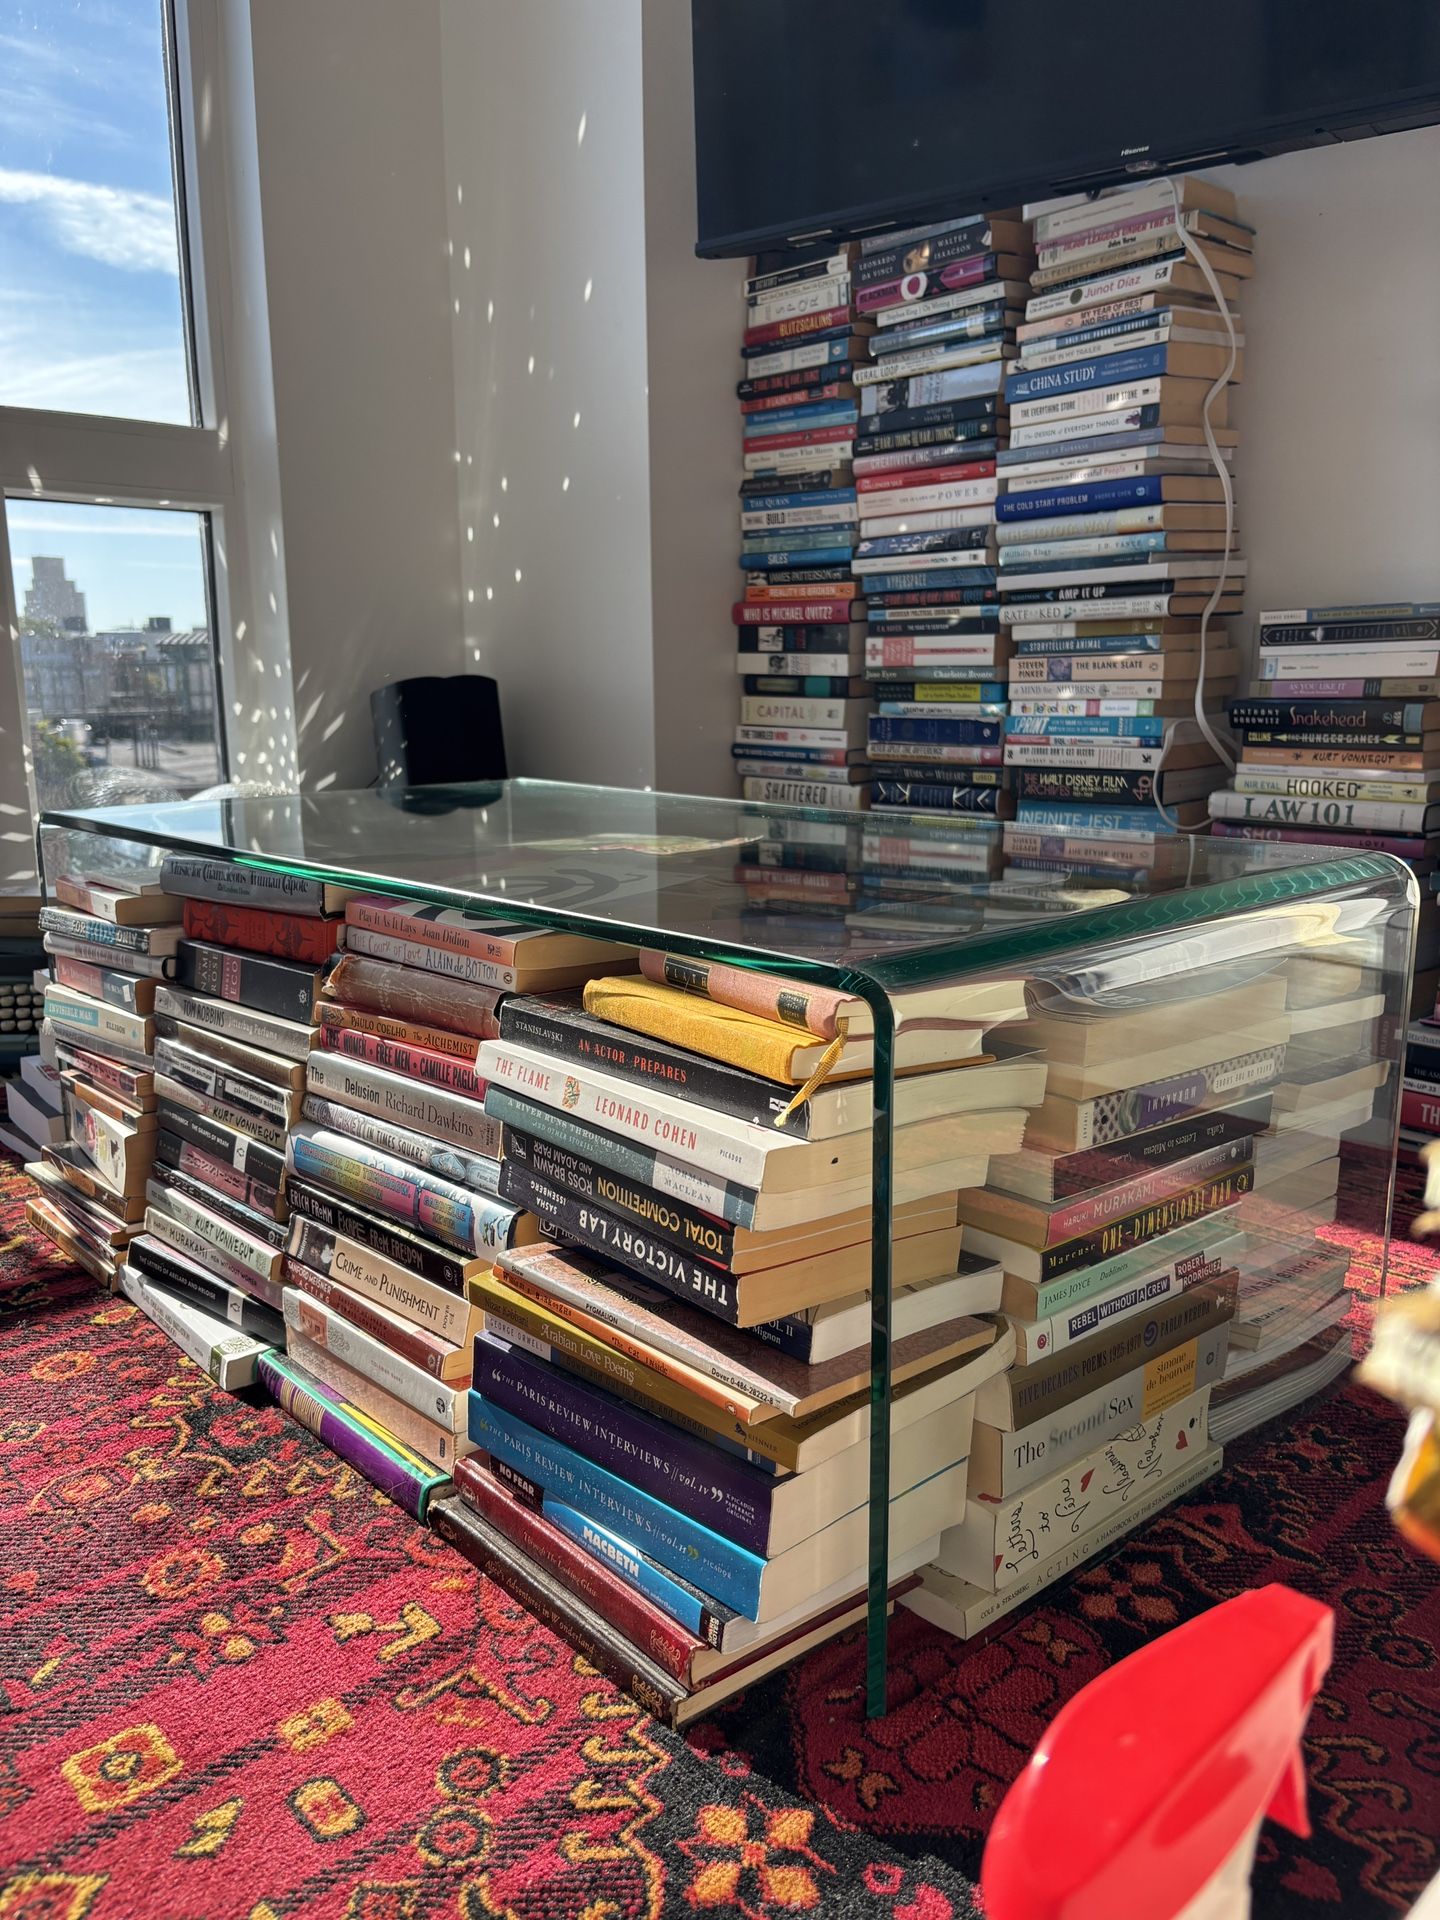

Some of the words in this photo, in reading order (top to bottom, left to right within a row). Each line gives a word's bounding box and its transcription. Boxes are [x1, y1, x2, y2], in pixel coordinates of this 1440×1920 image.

[1121, 145, 1149, 156] Hisense
[937, 233, 968, 248] WALTER
[858, 254, 896, 271] LEONARDO
[1084, 280, 1115, 299] Junot
[1080, 309, 1094, 319] MY
[1096, 305, 1114, 317] YEAR
[1114, 302, 1123, 313] OF
[1124, 298, 1143, 311] REST
[779, 313, 832, 337] BLITZSCALING
[1081, 316, 1095, 327] AND
[1030, 371, 1062, 392] CHINA
[1063, 366, 1096, 385] STUDY
[1021, 408, 1030, 418] THE
[1031, 404, 1059, 417] EVERYTHING
[1061, 401, 1075, 412] STORE
[1033, 428, 1056, 439] DESIGN
[1064, 423, 1094, 436] EVERYDAY
[1096, 418, 1120, 430] THINGS
[937, 488, 980, 499] POWER
[1003, 504, 1015, 512] THE
[1017, 501, 1034, 511] COLD
[1035, 498, 1055, 508] START
[1057, 494, 1088, 507] PROBLEM
[767, 512, 786, 524] BUILD
[769, 587, 796, 597] REALITY
[798, 587, 806, 595] IS
[1059, 588, 1080, 601] AMP
[1082, 587, 1091, 599] IT
[1092, 585, 1105, 597] UP
[743, 608, 761, 621] WHO
[763, 608, 770, 621] IS
[772, 607, 802, 621] MICHAEL
[803, 606, 832, 620] OVITZ?
[1029, 641, 1074, 651] STORYTELLING
[1075, 640, 1101, 649] ANIMAL
[865, 670, 881, 678] Jane
[883, 671, 896, 679] Eyre
[933, 670, 966, 679] Charlotte
[1018, 670, 1044, 678] PINKER
[1120, 661, 1143, 669] SLATE
[757, 705, 804, 719] CAPITAL
[1290, 707, 1366, 726] Snakehead
[1011, 718, 1050, 733] SPRINT
[1248, 732, 1271, 741] COLLINS
[1301, 733, 1343, 743] HUNGER
[1346, 734, 1380, 744] GAMES
[1312, 752, 1339, 761] KURT
[1341, 754, 1395, 764] VONNEGUT
[1024, 773, 1038, 784] THE
[1040, 773, 1064, 785] WALT
[1065, 774, 1100, 787] DISNEY
[1103, 775, 1127, 788] FILM
[1024, 784, 1070, 795] ARCHIVES
[1244, 780, 1259, 789] NIR
[1261, 781, 1280, 790] EYAL
[1287, 779, 1358, 798] HOOKED
[765, 783, 826, 804] SHATTERED
[1244, 798, 1306, 821] LAW
[1311, 803, 1354, 826] 101
[250, 872, 280, 889] Truman
[72, 920, 85, 934] FOR
[117, 929, 138, 946] ONLY
[422, 922, 441, 940] Joan
[442, 929, 469, 948] Didion
[425, 948, 453, 971] ALAIN
[465, 960, 498, 981] BOTTON
[48, 1004, 78, 1016] INVISIBLE
[79, 1009, 92, 1021] MAN
[106, 1021, 125, 1034] ELLISON
[183, 1001, 196, 1016] TOM
[198, 1004, 225, 1028] ROBBINS
[351, 1016, 375, 1032] PAULO
[376, 1020, 407, 1038] COELHO
[515, 1021, 563, 1042] STANISLAVSKI
[578, 1038, 590, 1052] AN
[594, 1043, 625, 1064] ACTOR
[633, 1055, 687, 1083] PREPARES
[376, 1043, 393, 1066] FREE
[394, 1048, 411, 1071] MEN
[419, 1056, 451, 1084] CAMILLE
[311, 1066, 324, 1085] The
[345, 1077, 380, 1105] Delusion
[385, 1090, 424, 1120] Richard
[426, 1105, 474, 1138] Dawkins
[496, 1057, 512, 1076] THE
[517, 1066, 550, 1091] FLAME
[595, 1095, 649, 1130] LEONARD
[654, 1119, 698, 1150] COHEN
[1147, 1085, 1196, 1112] MURAKAMI
[213, 1105, 233, 1123] KURT
[235, 1117, 280, 1143] VONNEGUT
[1207, 1123, 1224, 1136] Kafka
[533, 1141, 551, 1158] PARR
[1176, 1132, 1196, 1147] Letters
[533, 1154, 566, 1185] BRAWN
[554, 1150, 578, 1171] ADAM
[530, 1180, 566, 1205] ISSENBERG
[569, 1171, 592, 1196] ROSS
[290, 1190, 308, 1211] ERICH
[536, 1197, 557, 1214] SASHA
[598, 1176, 680, 1231] COMPETITION
[1063, 1212, 1089, 1229] HARUKI
[1093, 1183, 1155, 1218] MURAKAMI
[579, 1209, 607, 1235] LAB
[1102, 1187, 1206, 1254] ONE-DIMENSIONAL
[1210, 1180, 1232, 1202] MAN
[169, 1227, 208, 1259] MURAKAMI
[195, 1217, 214, 1235] KURT
[215, 1227, 254, 1260] VONNEGUT
[684, 1218, 724, 1255] TOTAL
[612, 1227, 686, 1283] VICTORY
[1178, 1254, 1204, 1274] ROBERT
[169, 1270, 187, 1285] ABELARD
[188, 1279, 198, 1290] AND
[1183, 1259, 1221, 1285] RODRIGUEZ
[693, 1269, 728, 1305] THE
[1044, 1288, 1067, 1309] JAMES
[1069, 1277, 1091, 1297] JOYCE
[1099, 1263, 1128, 1281] Dubliners
[586, 1303, 618, 1325] PYGMALION
[1071, 1310, 1097, 1332] REBEL
[1100, 1292, 1137, 1317] WITHOUT
[1148, 1278, 1168, 1296] CREW
[517, 1331, 543, 1351] ORWELL
[541, 1325, 577, 1352] Arabian
[580, 1343, 601, 1365] Love
[604, 1356, 634, 1385] Poems
[1019, 1386, 1040, 1408] FIVE
[1082, 1352, 1108, 1377] POEMS
[1160, 1319, 1181, 1337] PABLO
[1183, 1303, 1210, 1325] NERUDA
[1157, 1352, 1186, 1374] simone
[711, 1368, 730, 1382] Dover
[1146, 1377, 1157, 1392] de
[516, 1380, 546, 1407] PARIS
[549, 1401, 592, 1430] REVIEW
[595, 1421, 670, 1475] INTERVIEWS
[1014, 1440, 1045, 1469] The
[1051, 1412, 1106, 1448] Second
[1108, 1394, 1135, 1420] Sex
[504, 1432, 531, 1458] PARIS
[500, 1464, 512, 1479] NO
[513, 1472, 534, 1497] FEAR
[1103, 1446, 1136, 1501] Vladimir
[1039, 1512, 1050, 1532] to
[583, 1525, 640, 1577] MACBETH
[1037, 1544, 1089, 1585] ACTING
